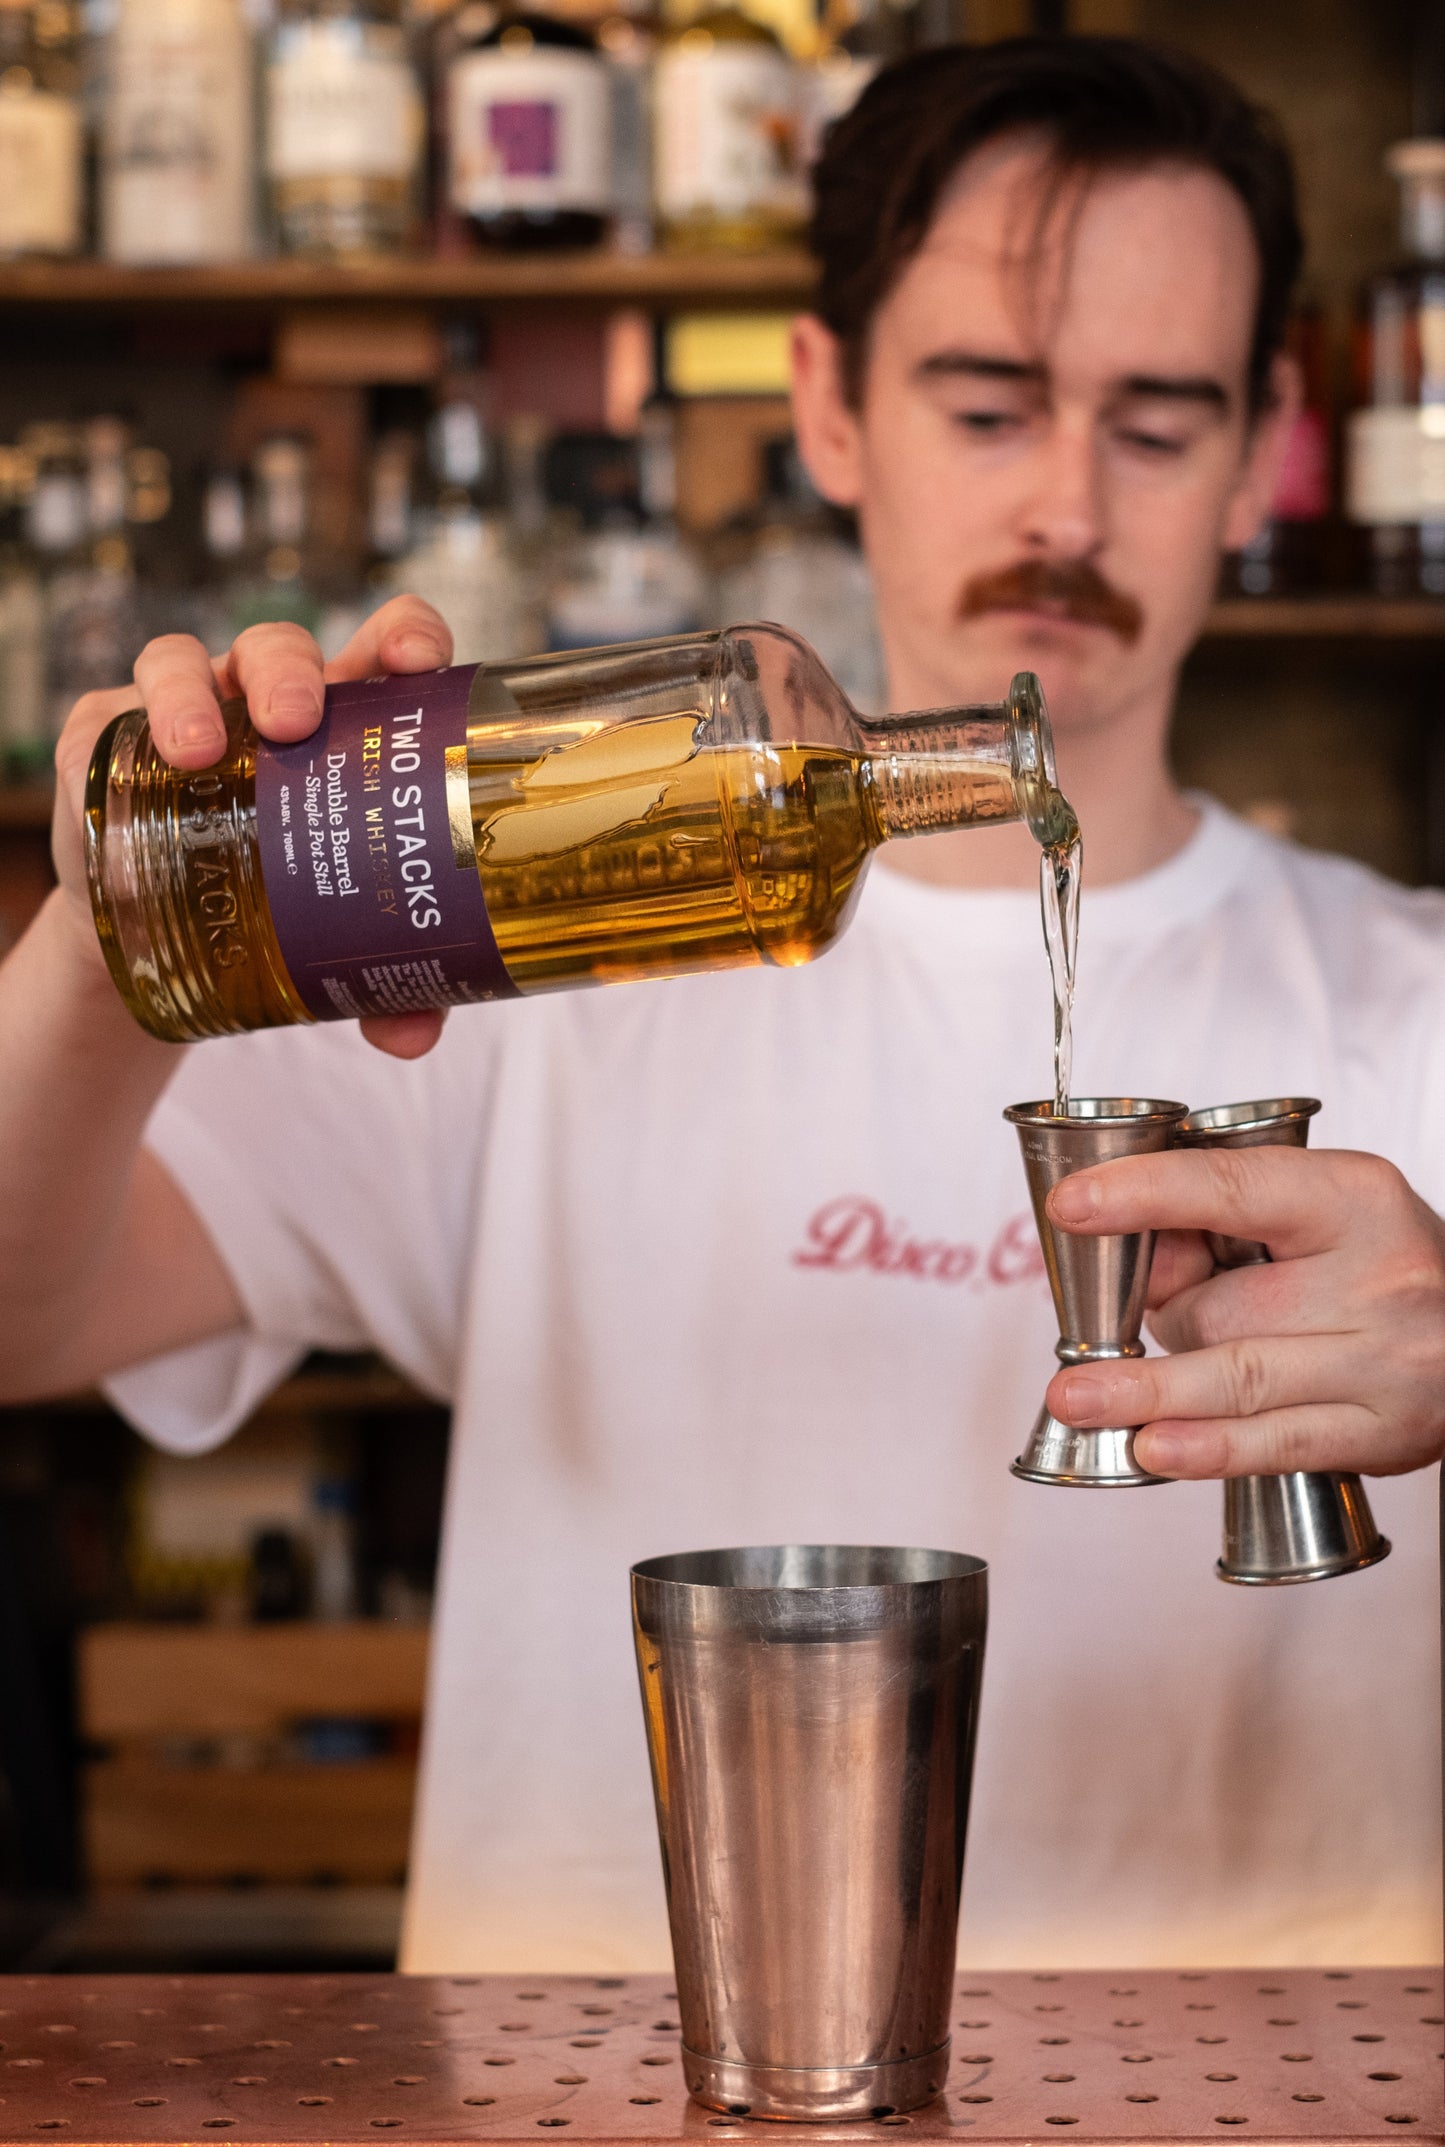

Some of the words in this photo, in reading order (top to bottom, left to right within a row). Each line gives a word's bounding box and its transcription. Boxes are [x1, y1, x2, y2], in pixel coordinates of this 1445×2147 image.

[363, 725, 382, 792] IRISH
[391, 708, 423, 773] TWO
[326, 752, 348, 826] Double
[309, 829, 325, 858] Pot
[331, 828, 359, 897] Barrel
[365, 807, 399, 915] WHISKEY
[392, 785, 441, 929] STACKS
[313, 861, 334, 896] Still
